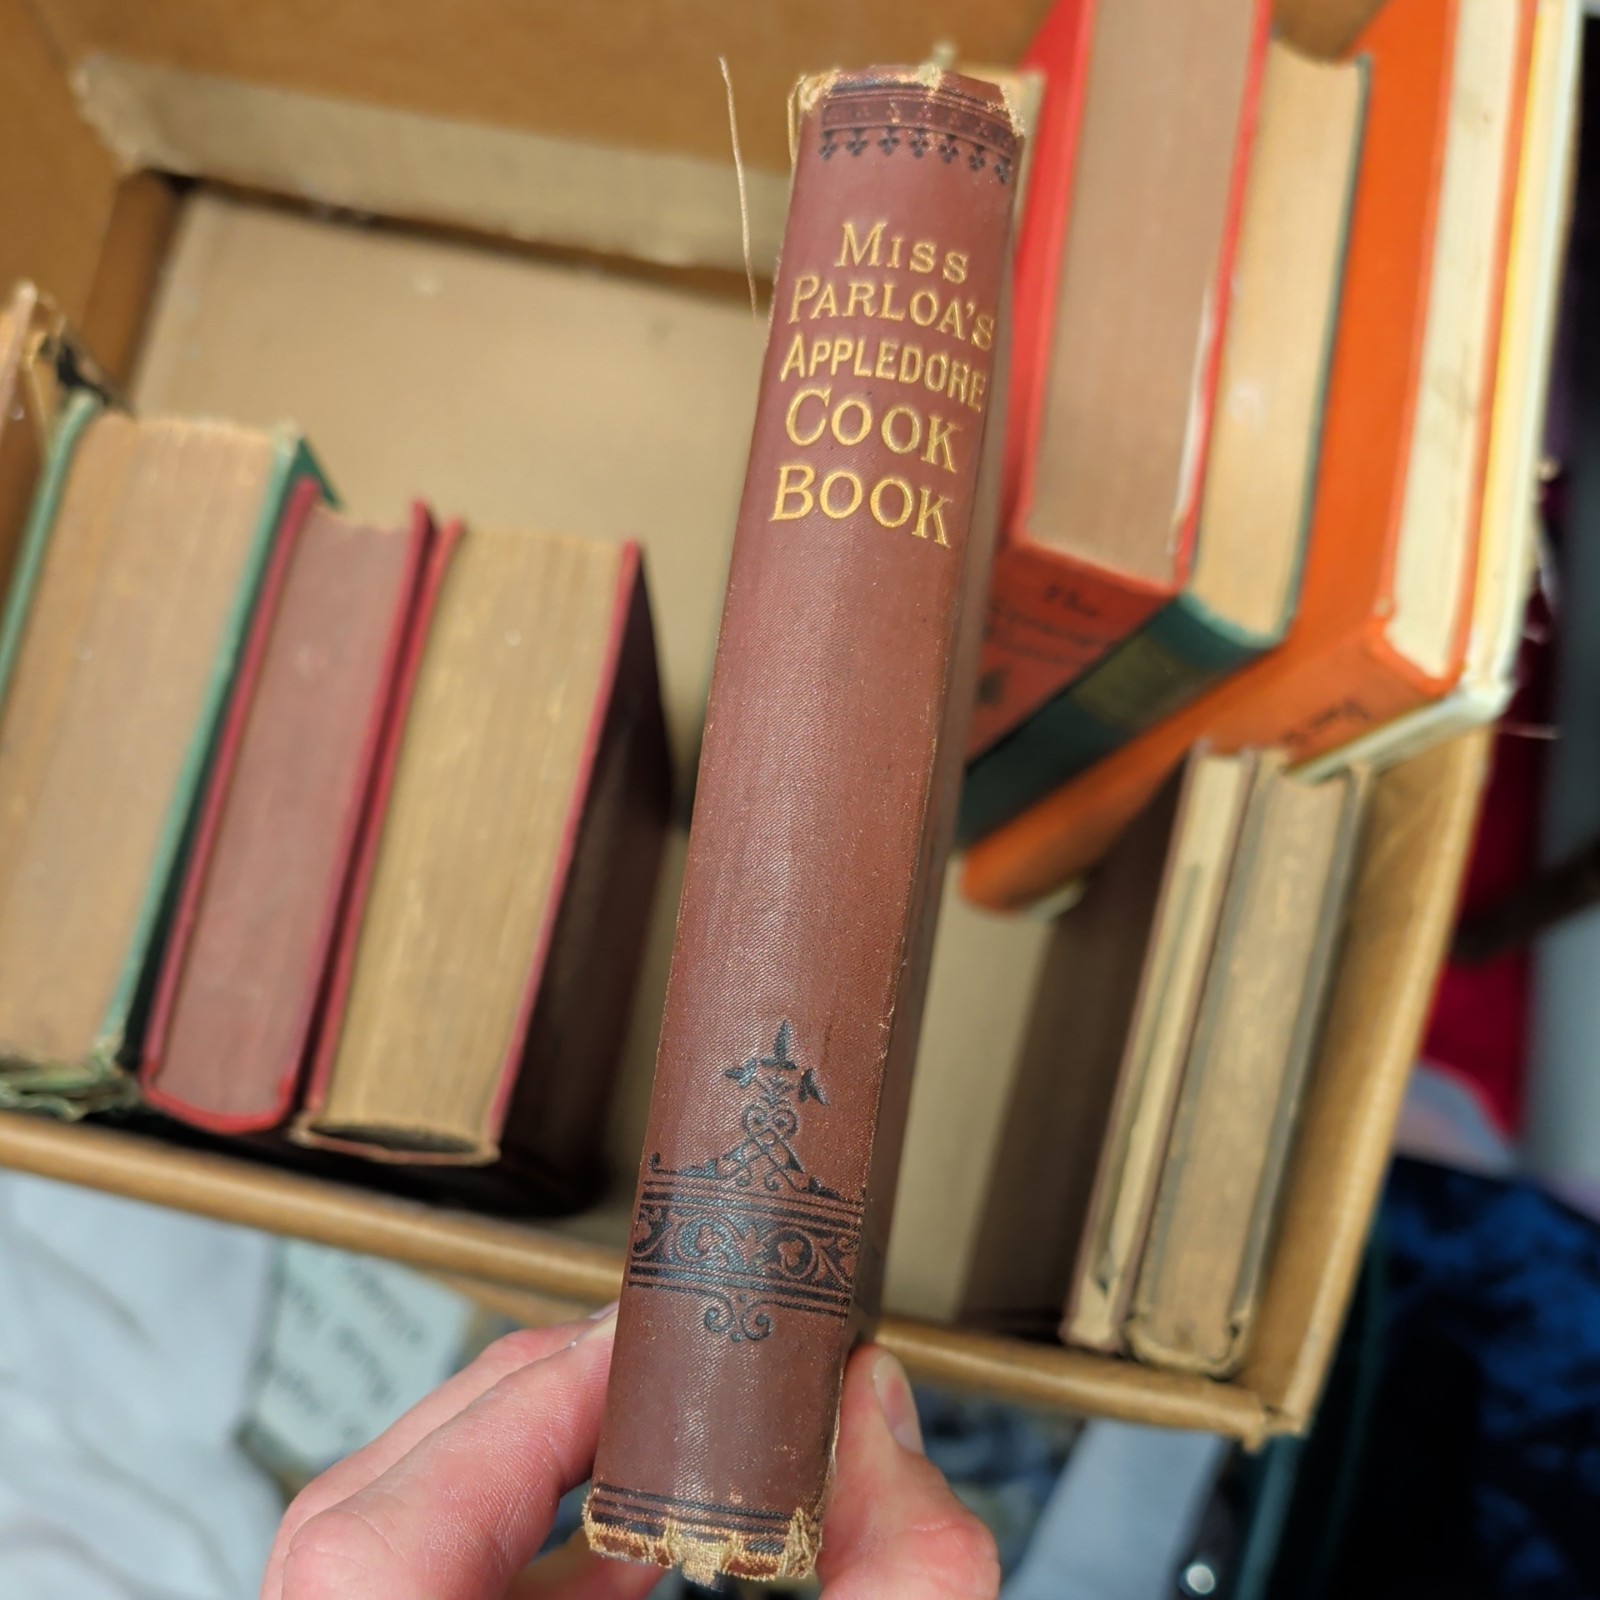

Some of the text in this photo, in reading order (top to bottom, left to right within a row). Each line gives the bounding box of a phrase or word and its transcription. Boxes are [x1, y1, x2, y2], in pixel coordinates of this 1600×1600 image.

[788, 275, 995, 350] PARLOA'S
[780, 333, 987, 413] APPLEDORE
[785, 387, 962, 473] COOK
[769, 463, 953, 549] BOOK
